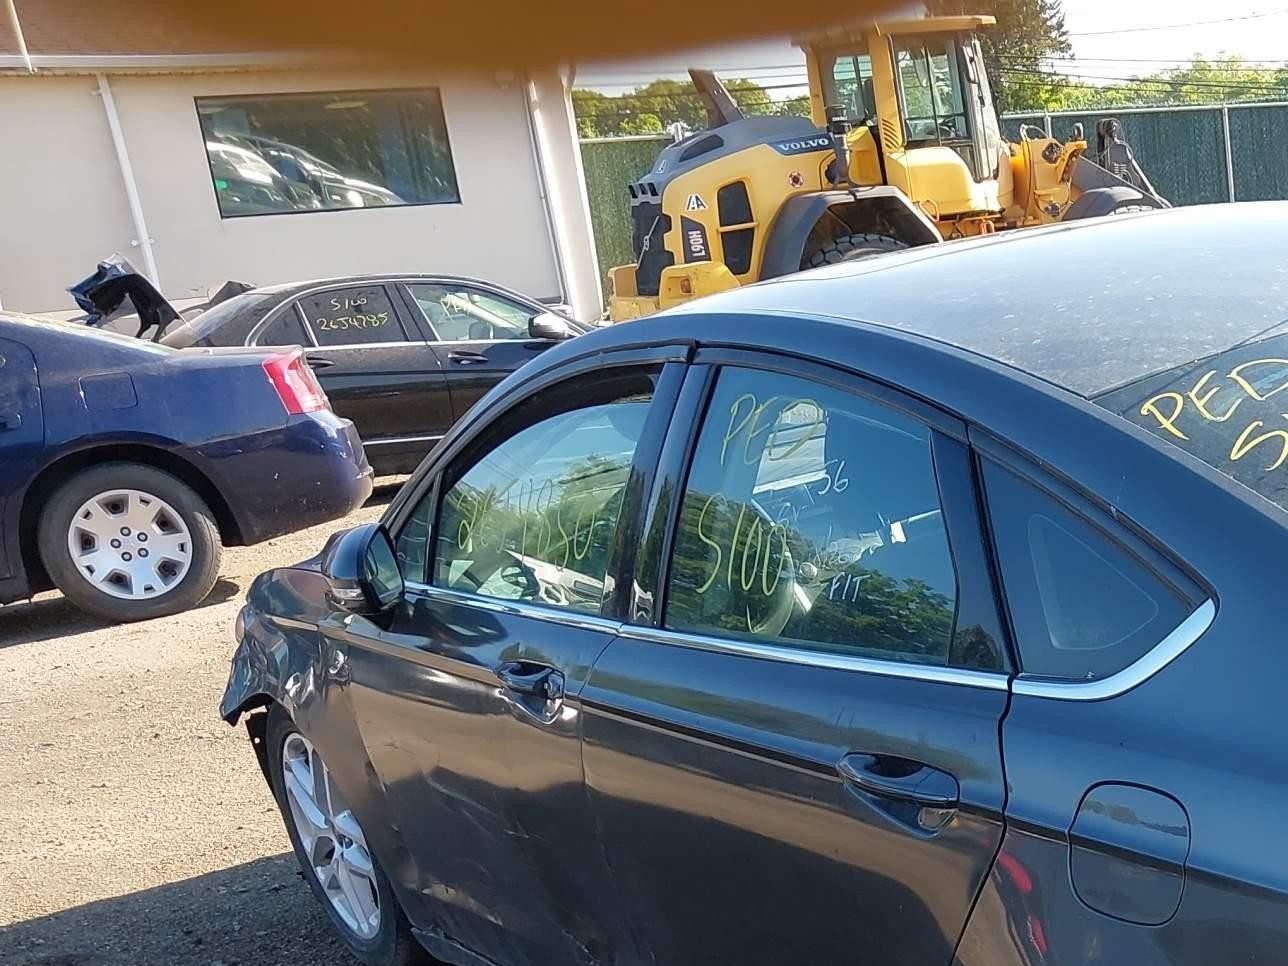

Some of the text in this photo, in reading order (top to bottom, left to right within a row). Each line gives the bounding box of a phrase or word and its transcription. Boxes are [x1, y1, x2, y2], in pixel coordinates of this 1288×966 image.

[777, 137, 830, 151] VOLVO
[687, 230, 706, 257] L90H
[720, 393, 820, 466] PED
